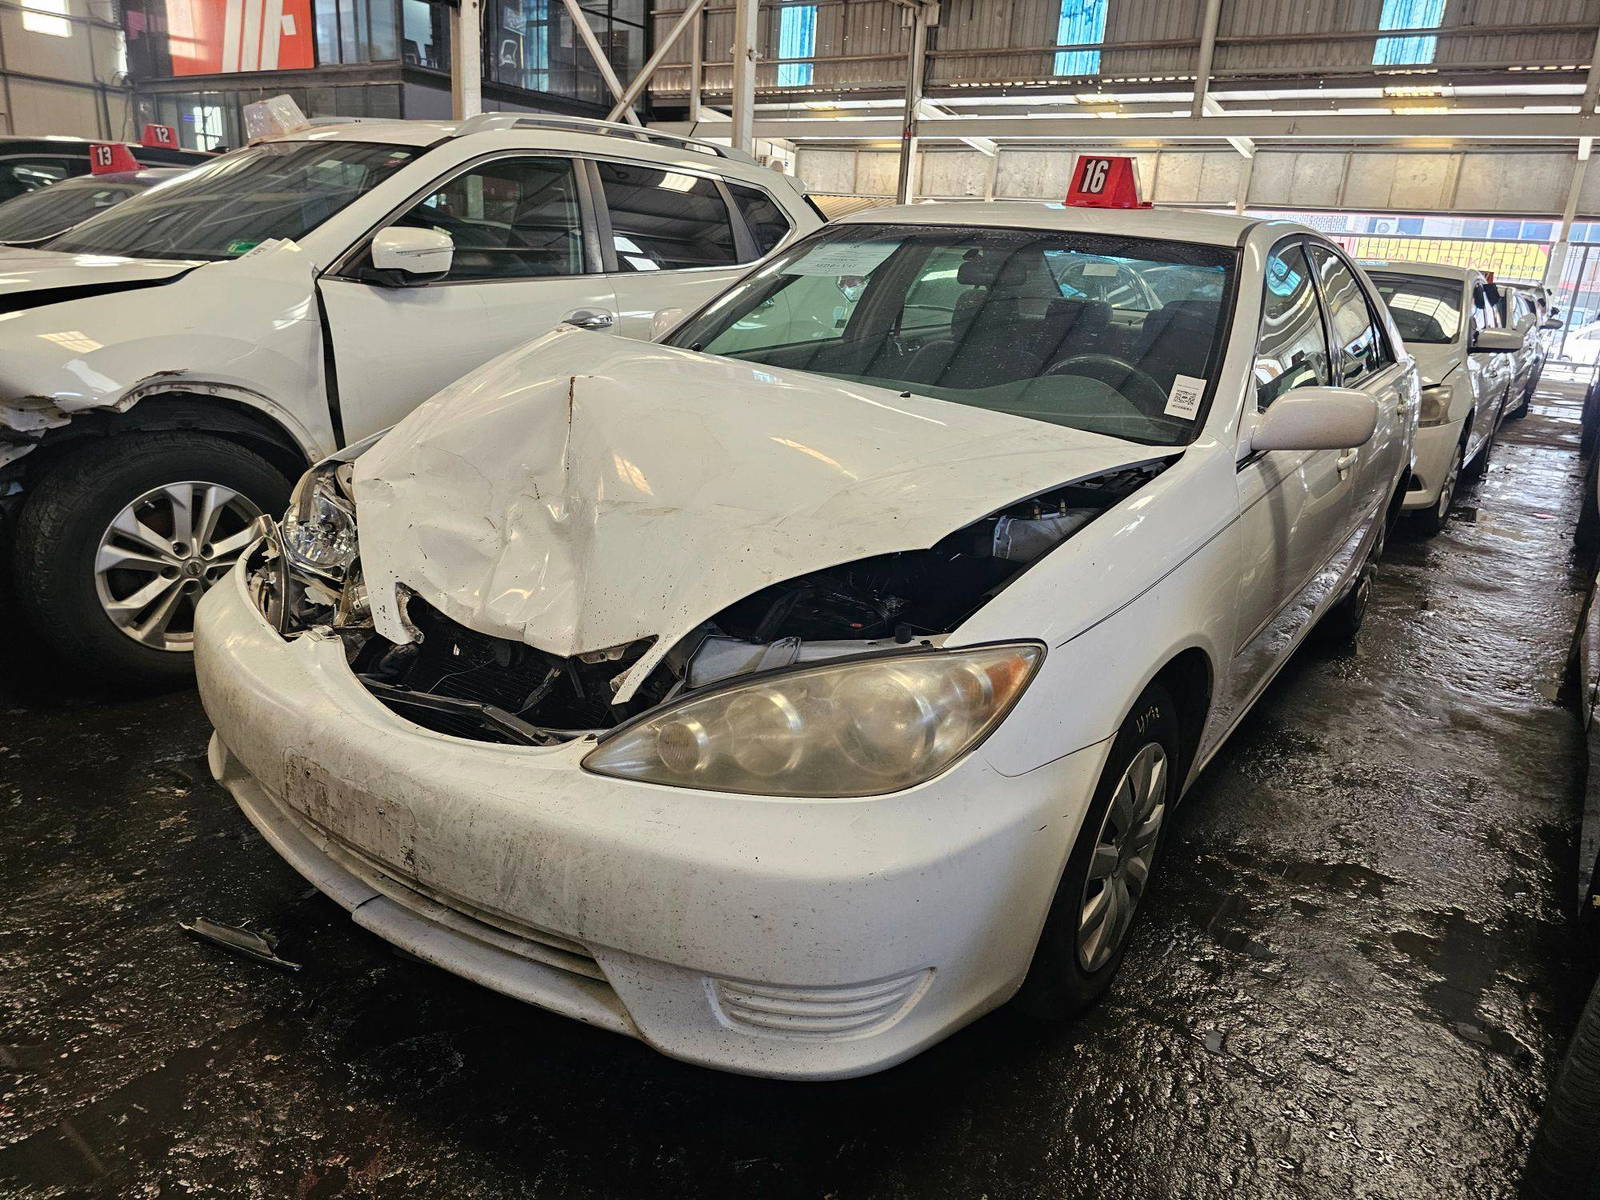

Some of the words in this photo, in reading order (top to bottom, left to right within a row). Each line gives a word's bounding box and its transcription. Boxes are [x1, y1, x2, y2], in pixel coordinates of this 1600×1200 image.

[156, 127, 170, 143] 12
[97, 146, 112, 166] 13
[1081, 159, 1109, 193] 16
[1504, 263, 1543, 273] TRADING
